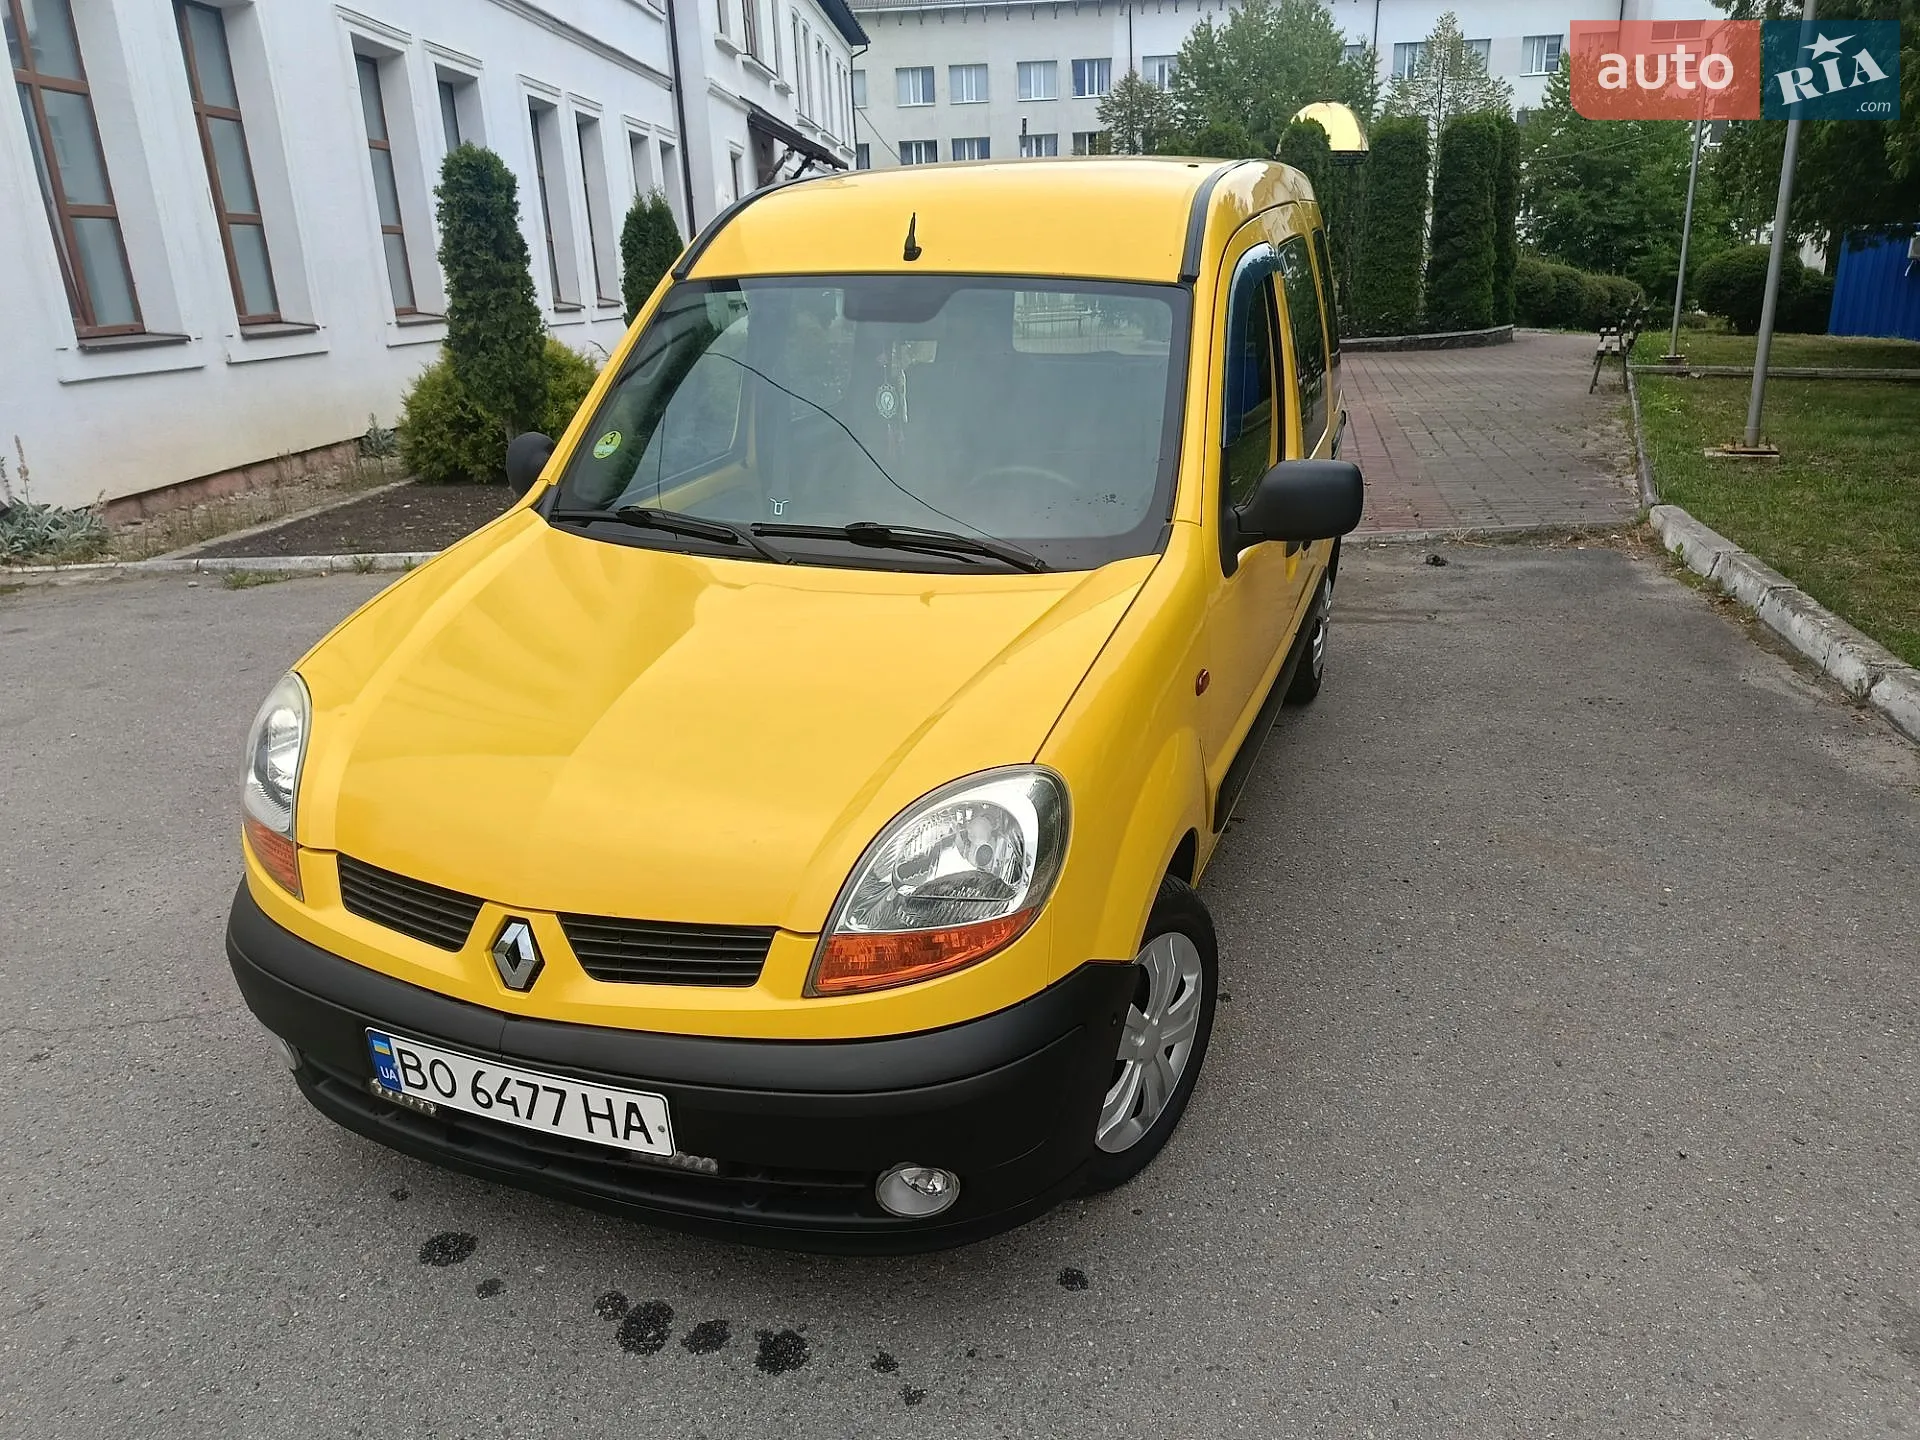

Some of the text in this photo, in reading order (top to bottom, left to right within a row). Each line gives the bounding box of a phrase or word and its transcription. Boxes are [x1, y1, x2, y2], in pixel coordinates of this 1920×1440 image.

[605, 431, 617, 445] 3
[380, 1065, 399, 1083] UA
[396, 1047, 653, 1145] BO 6477 HA
